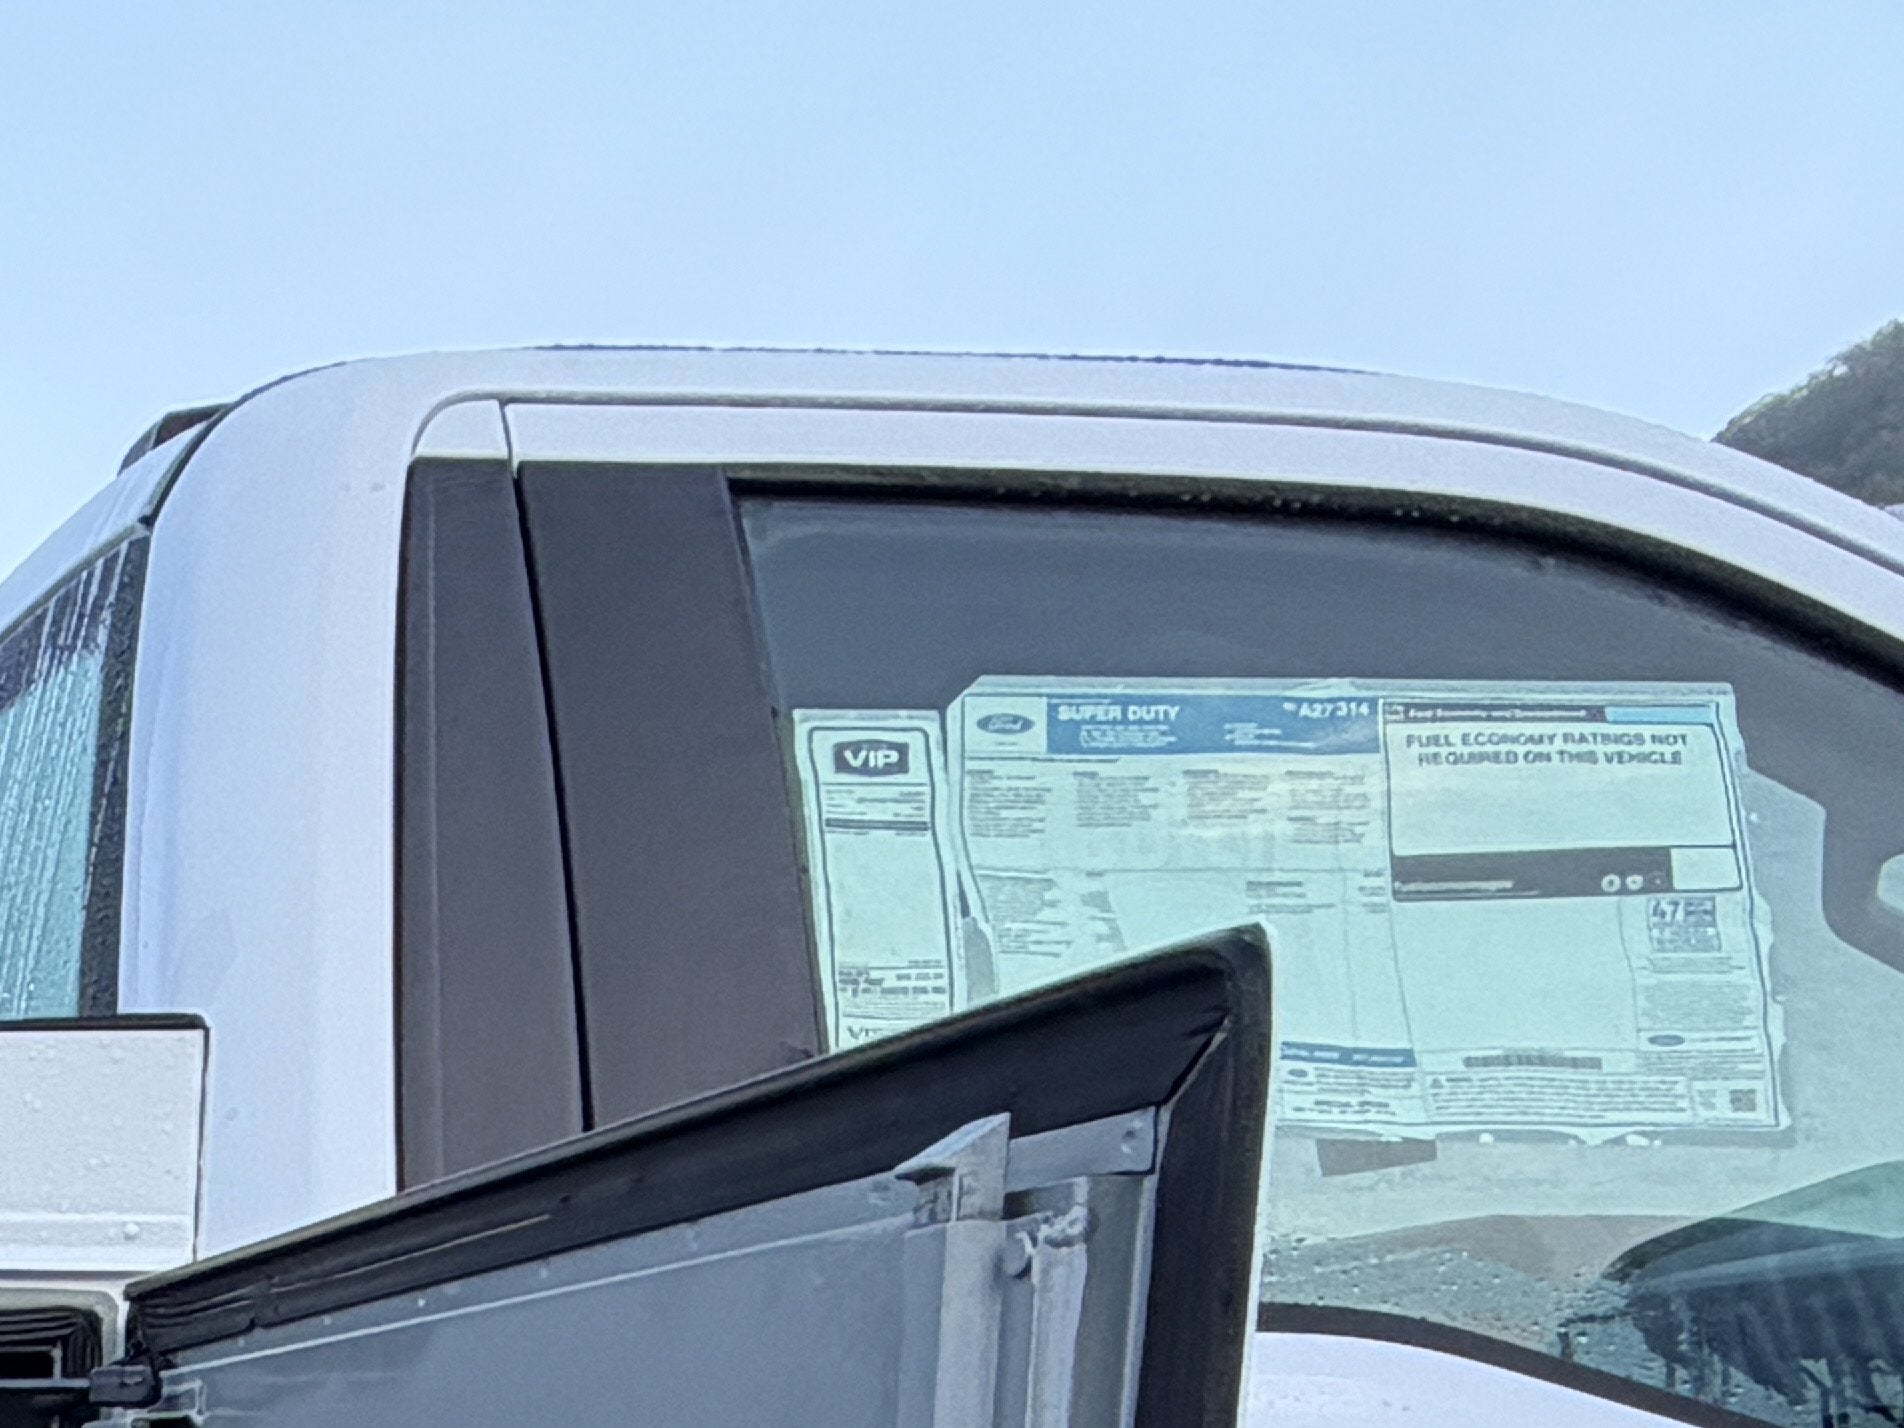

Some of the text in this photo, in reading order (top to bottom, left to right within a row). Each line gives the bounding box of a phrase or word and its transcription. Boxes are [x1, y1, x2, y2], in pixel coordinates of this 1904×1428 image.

[1057, 704, 1180, 721] SUPER DUTY
[1406, 731, 1688, 748] FUEL ECONOMY RATINGS NOT
[843, 748, 900, 769] VIP
[1418, 749, 1682, 767] REQUIRED ON THIS VEHICLE
